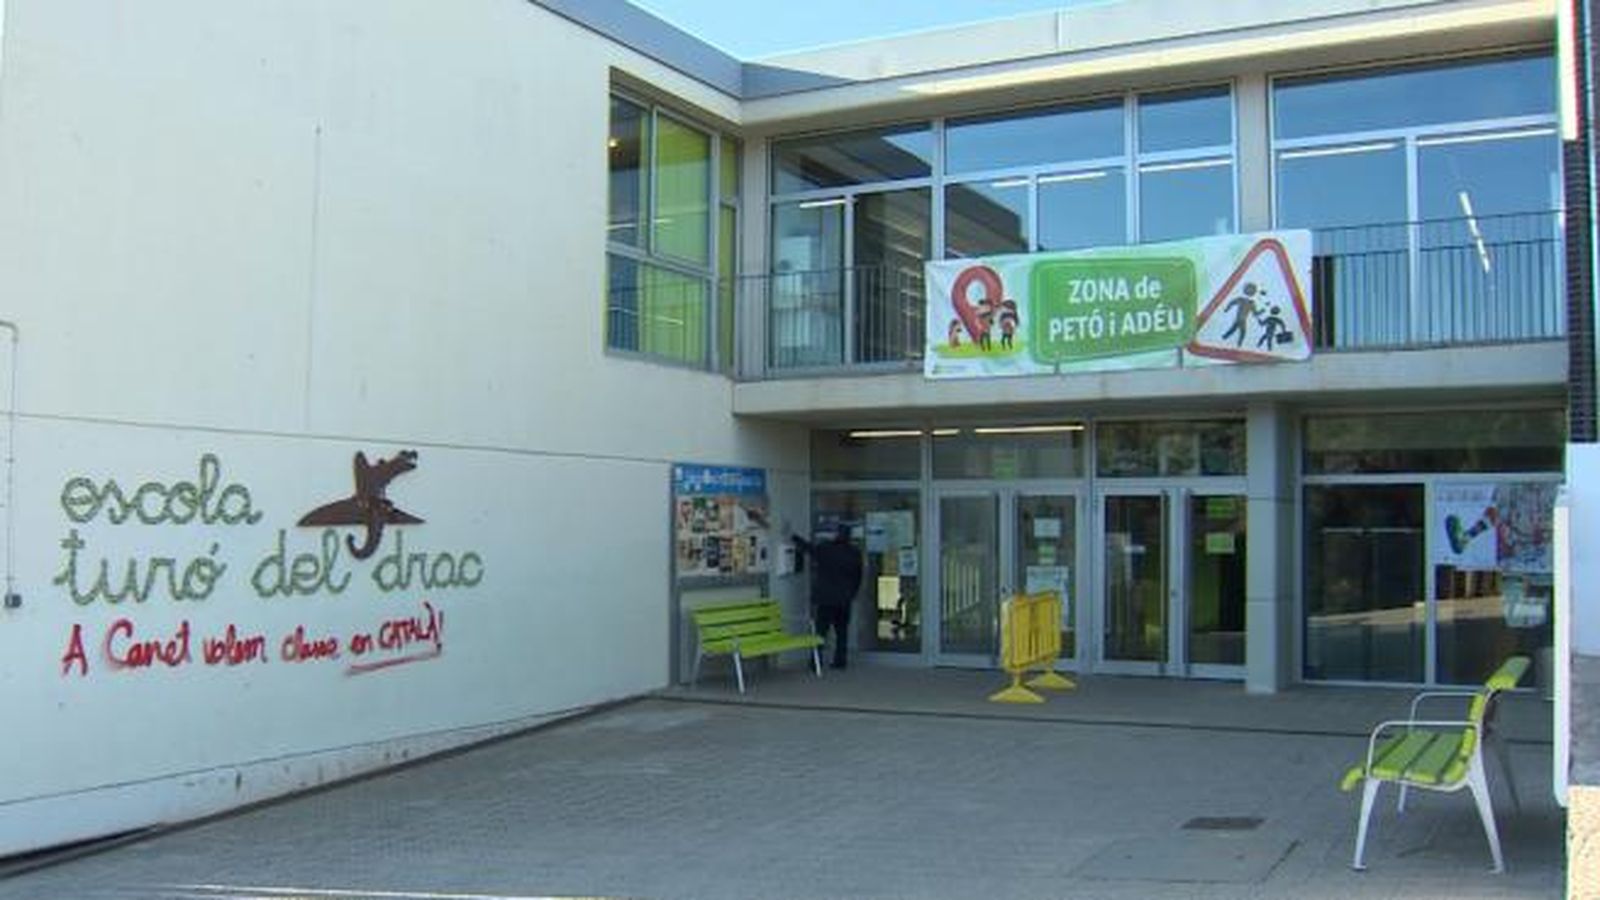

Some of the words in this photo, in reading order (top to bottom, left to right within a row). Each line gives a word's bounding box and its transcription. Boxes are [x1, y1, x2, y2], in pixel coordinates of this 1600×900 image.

[1069, 278, 1130, 304] ZONA
[1135, 276, 1162, 299] de
[1048, 309, 1104, 342] PETÓ
[1109, 312, 1116, 337] i
[1121, 303, 1184, 335] ADÉU
[61, 453, 263, 524] escola
[53, 529, 228, 606] turó
[251, 529, 351, 598] del
[371, 530, 484, 592] drac
[63, 624, 88, 676] A
[105, 619, 192, 667] Canet
[203, 624, 267, 665] volem
[351, 634, 373, 656] en
